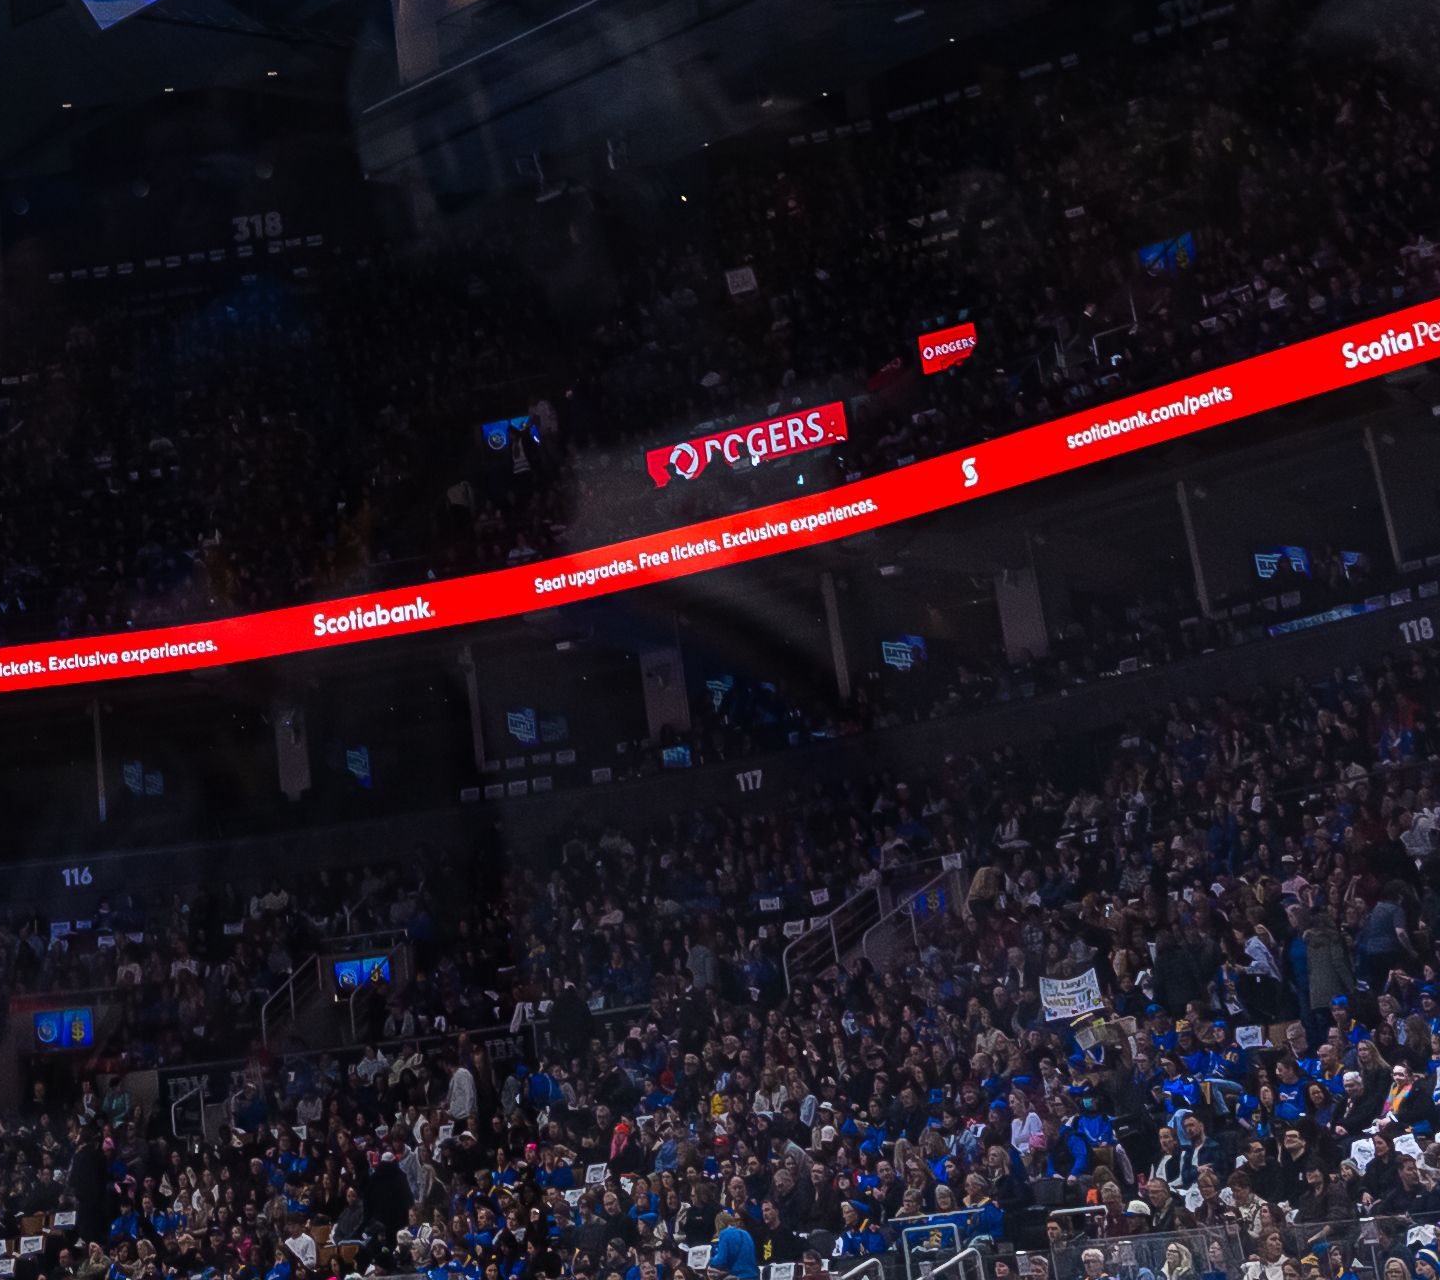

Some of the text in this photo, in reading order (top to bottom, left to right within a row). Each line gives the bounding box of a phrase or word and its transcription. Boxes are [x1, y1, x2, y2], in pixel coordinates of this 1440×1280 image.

[231, 209, 284, 243] 318
[1066, 382, 1234, 451] scotiabank.com/perks
[533, 497, 880, 596] Seat upgrades. Free tickets. Exclusive experiences.
[1397, 616, 1435, 644] 118
[48, 648, 119, 674] Exclusive
[120, 637, 219, 666] experiences.
[735, 768, 763, 793] 117
[61, 866, 94, 888] 116
